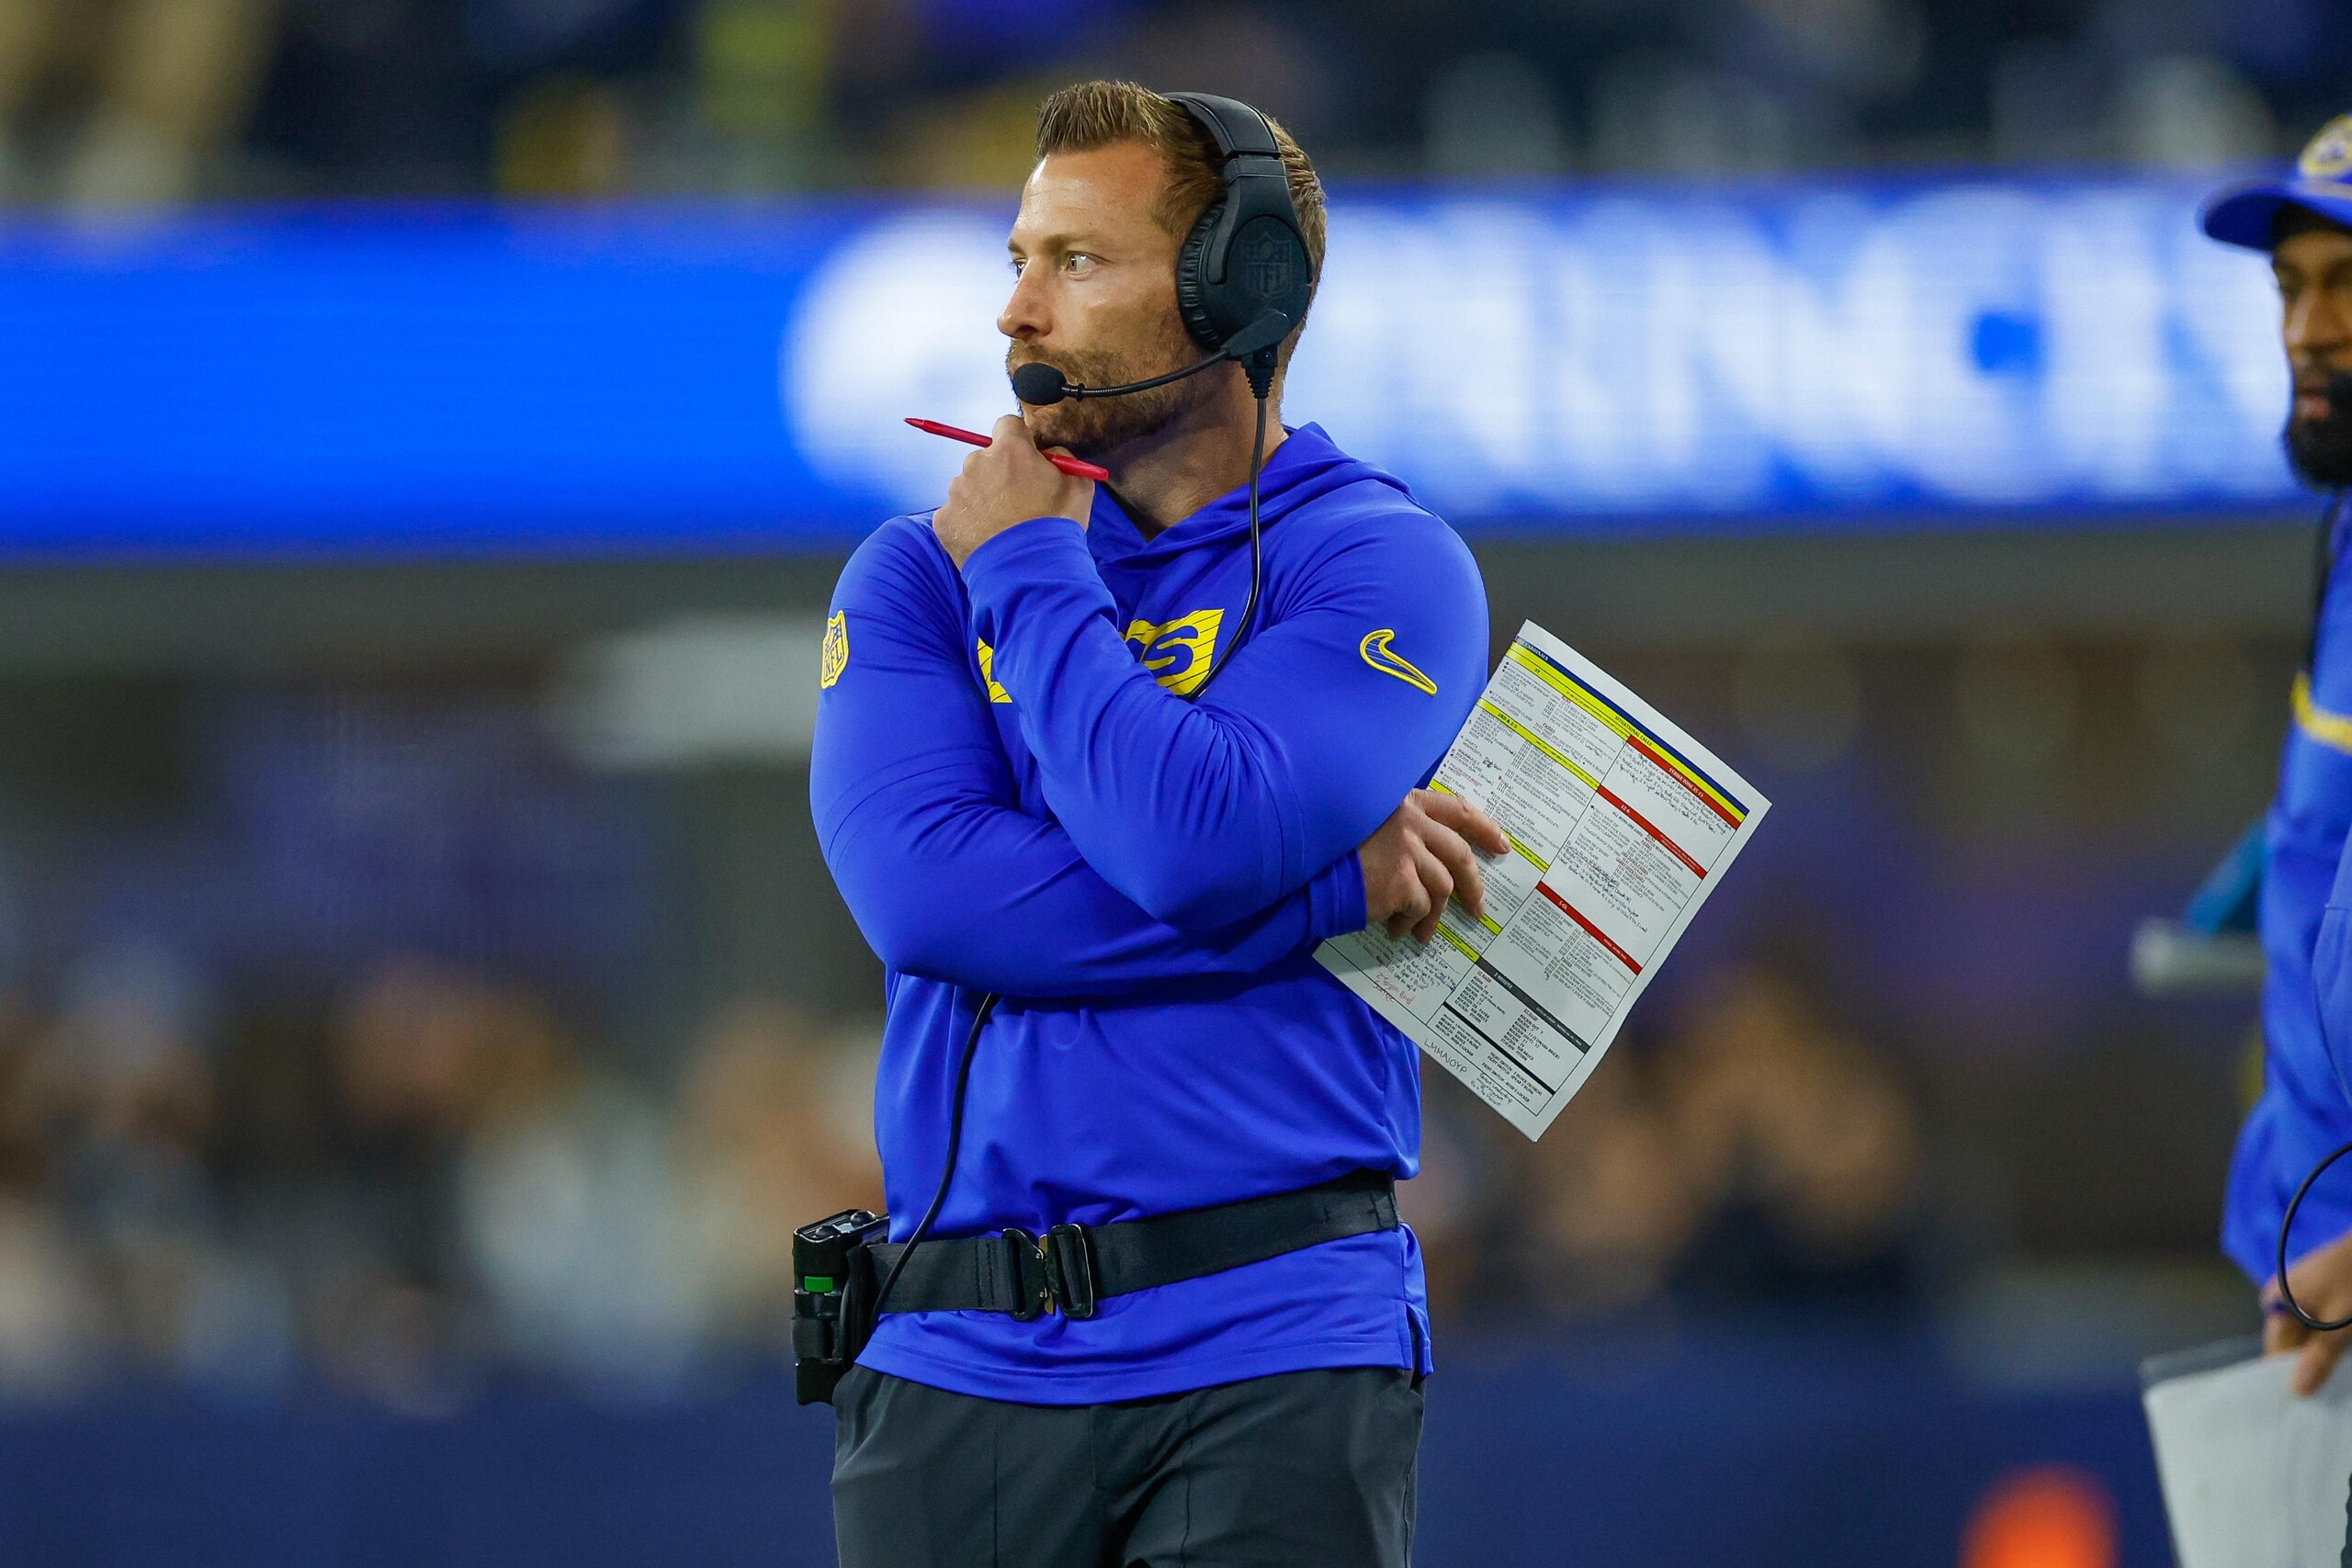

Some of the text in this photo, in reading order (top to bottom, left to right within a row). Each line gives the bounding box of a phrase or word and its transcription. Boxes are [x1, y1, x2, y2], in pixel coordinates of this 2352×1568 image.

[1614, 715, 1652, 747] SITUATIONAL CALLS
[1496, 974, 1512, 989] MINUTE
